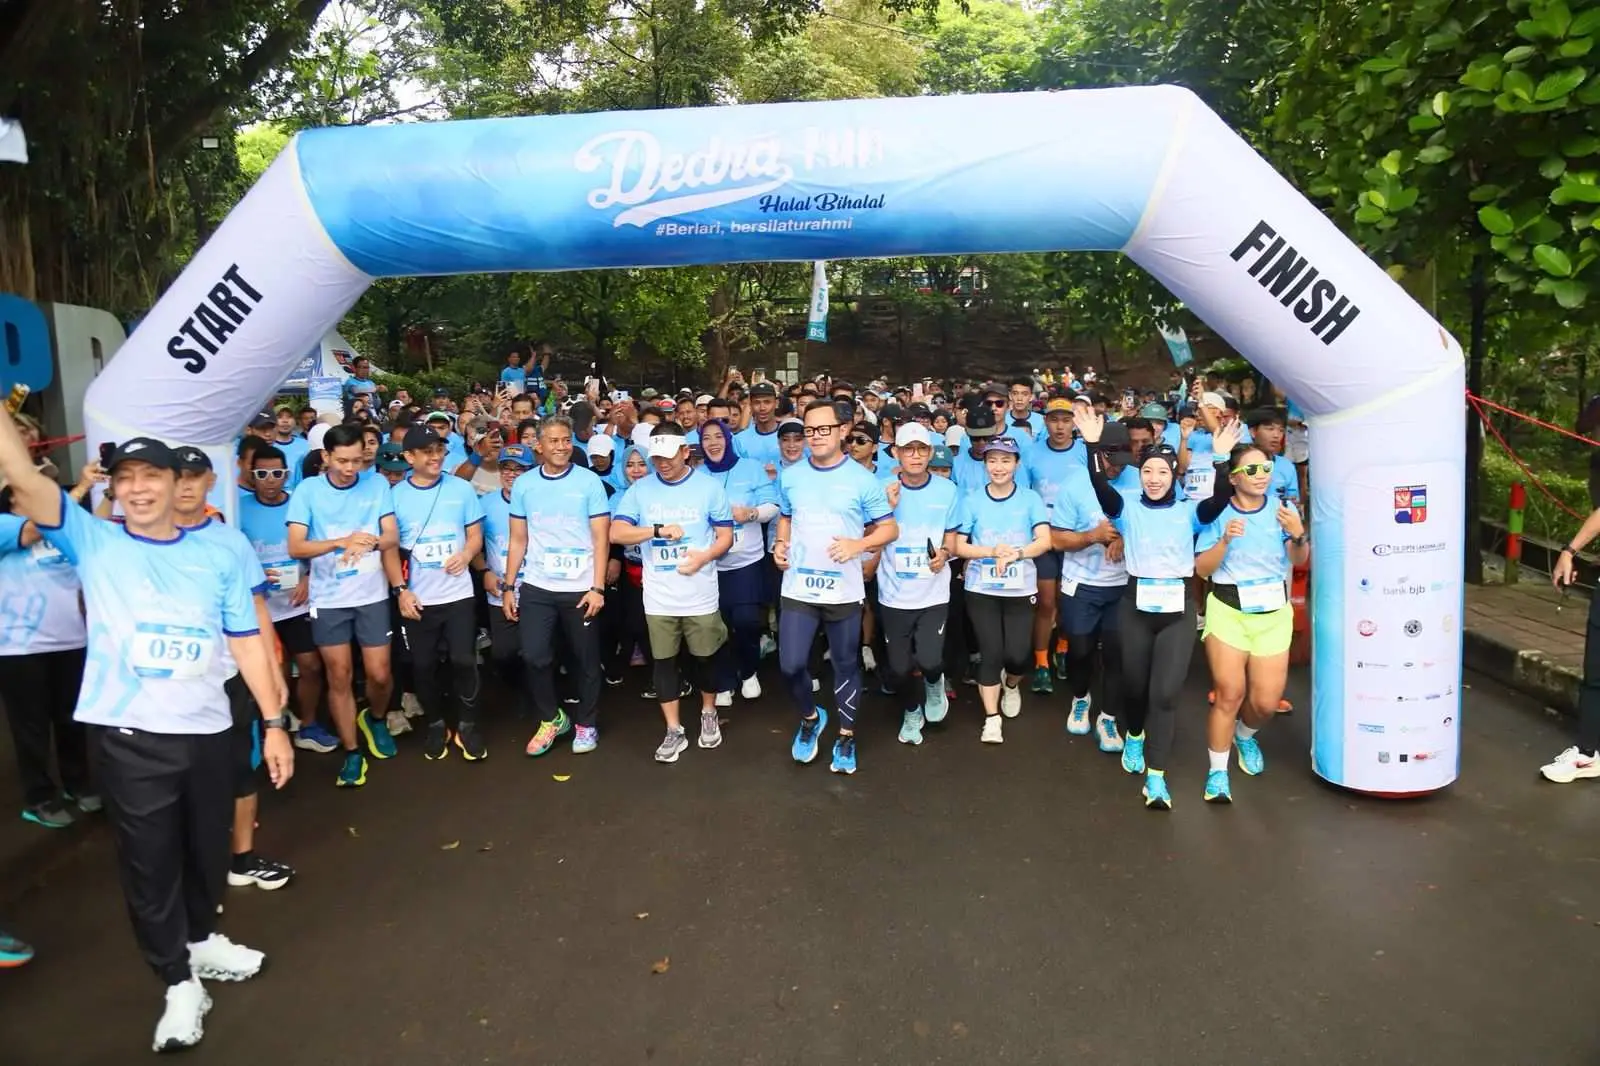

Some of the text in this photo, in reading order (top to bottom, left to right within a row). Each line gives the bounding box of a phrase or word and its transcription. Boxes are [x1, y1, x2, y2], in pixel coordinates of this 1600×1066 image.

[574, 129, 783, 210] Dedra
[759, 192, 886, 213] Halal Bihalal
[655, 216, 853, 237] #Berlari, bersilaturahmi
[1229, 219, 1361, 346] FINISH
[167, 263, 264, 374] START
[425, 544, 453, 557] 214
[553, 556, 580, 569] 361
[805, 576, 835, 590] 002
[149, 639, 202, 663] 059
